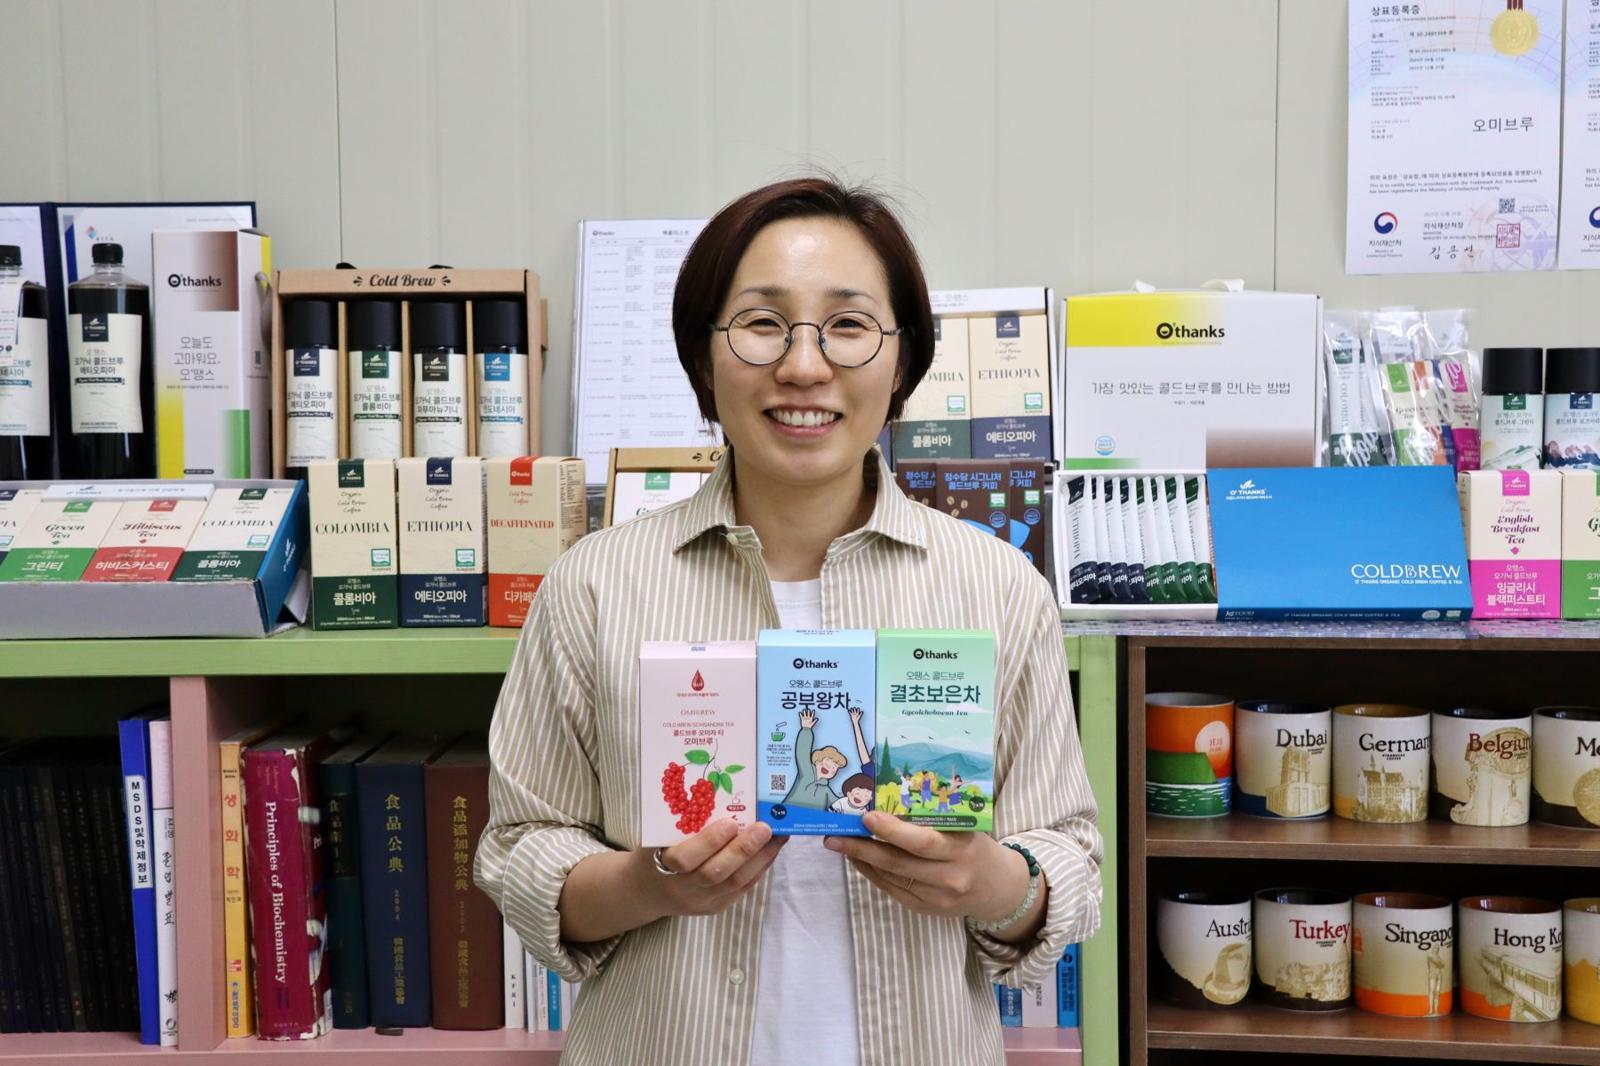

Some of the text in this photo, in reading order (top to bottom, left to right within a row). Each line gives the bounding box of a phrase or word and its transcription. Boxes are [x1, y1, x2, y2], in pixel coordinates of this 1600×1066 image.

[1371, 4, 1420, 17] 상표등록증
[1472, 116, 1535, 133] 오미브루
[369, 273, 436, 287] Cold Brew
[180, 336, 213, 349] 오늘도
[80, 366, 116, 374] 에티오피아
[978, 368, 1041, 380] ETHIOPIA
[1091, 381, 1292, 395] 가장 맛있는 콜드브루를 만나는 방법
[912, 434, 952, 448] 콜롬비아
[985, 430, 1037, 443] 에티오피아
[971, 472, 1001, 481] 시그니처
[1010, 470, 1036, 479] 그니처
[948, 481, 998, 490] 콜드브루 커피
[1016, 479, 1032, 487] 커피
[123, 522, 182, 530] Hibiscus
[407, 520, 472, 532] ETHIOPIA
[490, 519, 555, 529] DECAFFEINATED
[1497, 514, 1533, 526] English
[45, 523, 85, 532] Green
[315, 522, 390, 534] COLOMBIA
[1490, 524, 1540, 535] Breakfast
[1505, 534, 1525, 544] Tea
[22, 561, 65, 571] 그린티
[95, 561, 170, 570] 히비스커스티
[197, 559, 242, 569] 콜롬비아
[1496, 582, 1536, 594] 잉글리시
[333, 591, 377, 606] 콜롬비아
[414, 589, 468, 604] 에티오피아
[1487, 594, 1546, 606] 블랙퍼스트티
[932, 671, 965, 681] 콜드브루
[813, 679, 843, 688] 콜드브루
[781, 691, 851, 710] 공부왕차
[890, 684, 981, 705] 결초보은차
[673, 729, 697, 737] 콜드브루
[1276, 728, 1327, 748] Dubai
[684, 737, 714, 746] 오미브루
[385, 793, 404, 873] 食品公典
[265, 801, 288, 983] Principles of Biochemistry
[1289, 919, 1350, 943] Turkey
[1494, 928, 1546, 953] Hong
